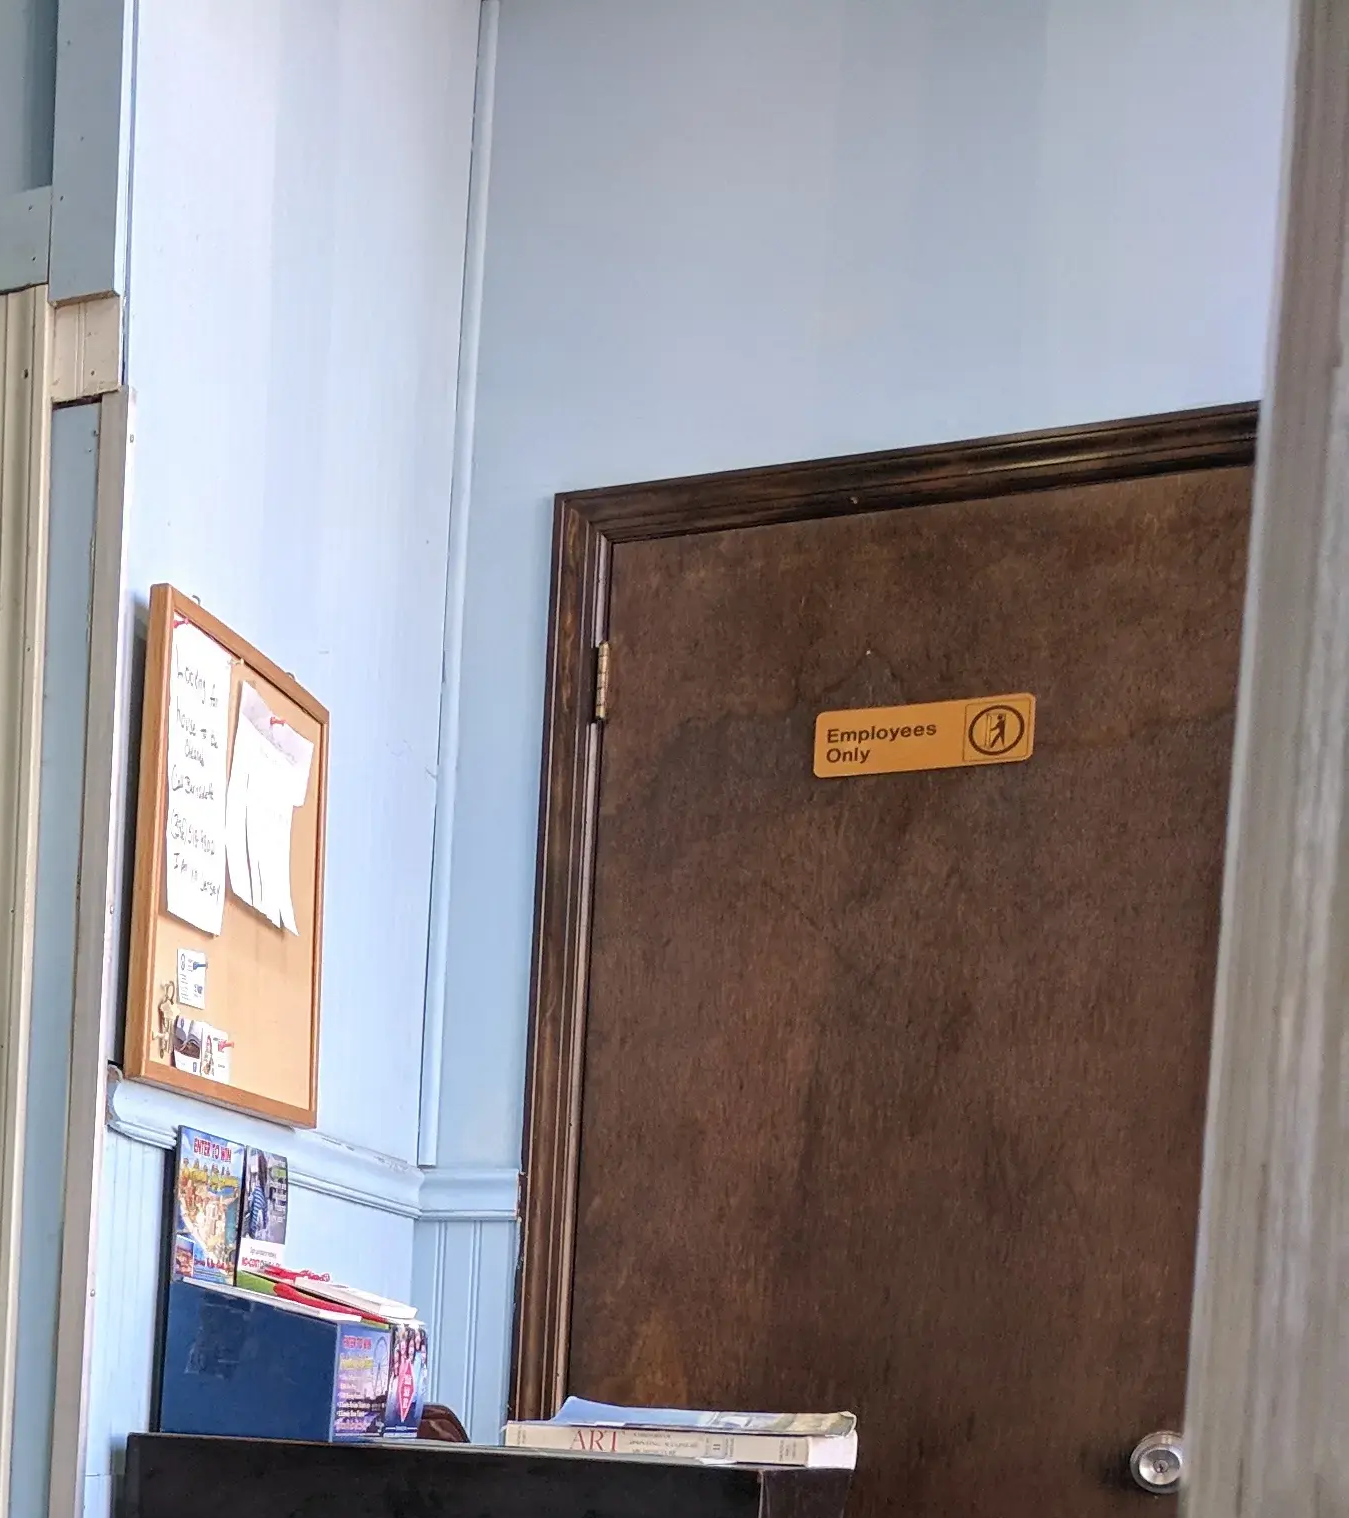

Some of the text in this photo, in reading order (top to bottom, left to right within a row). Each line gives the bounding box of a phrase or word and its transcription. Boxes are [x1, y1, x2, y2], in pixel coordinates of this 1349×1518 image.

[826, 723, 938, 745] Employees
[825, 748, 871, 764] Only
[569, 1428, 619, 1452] ART
